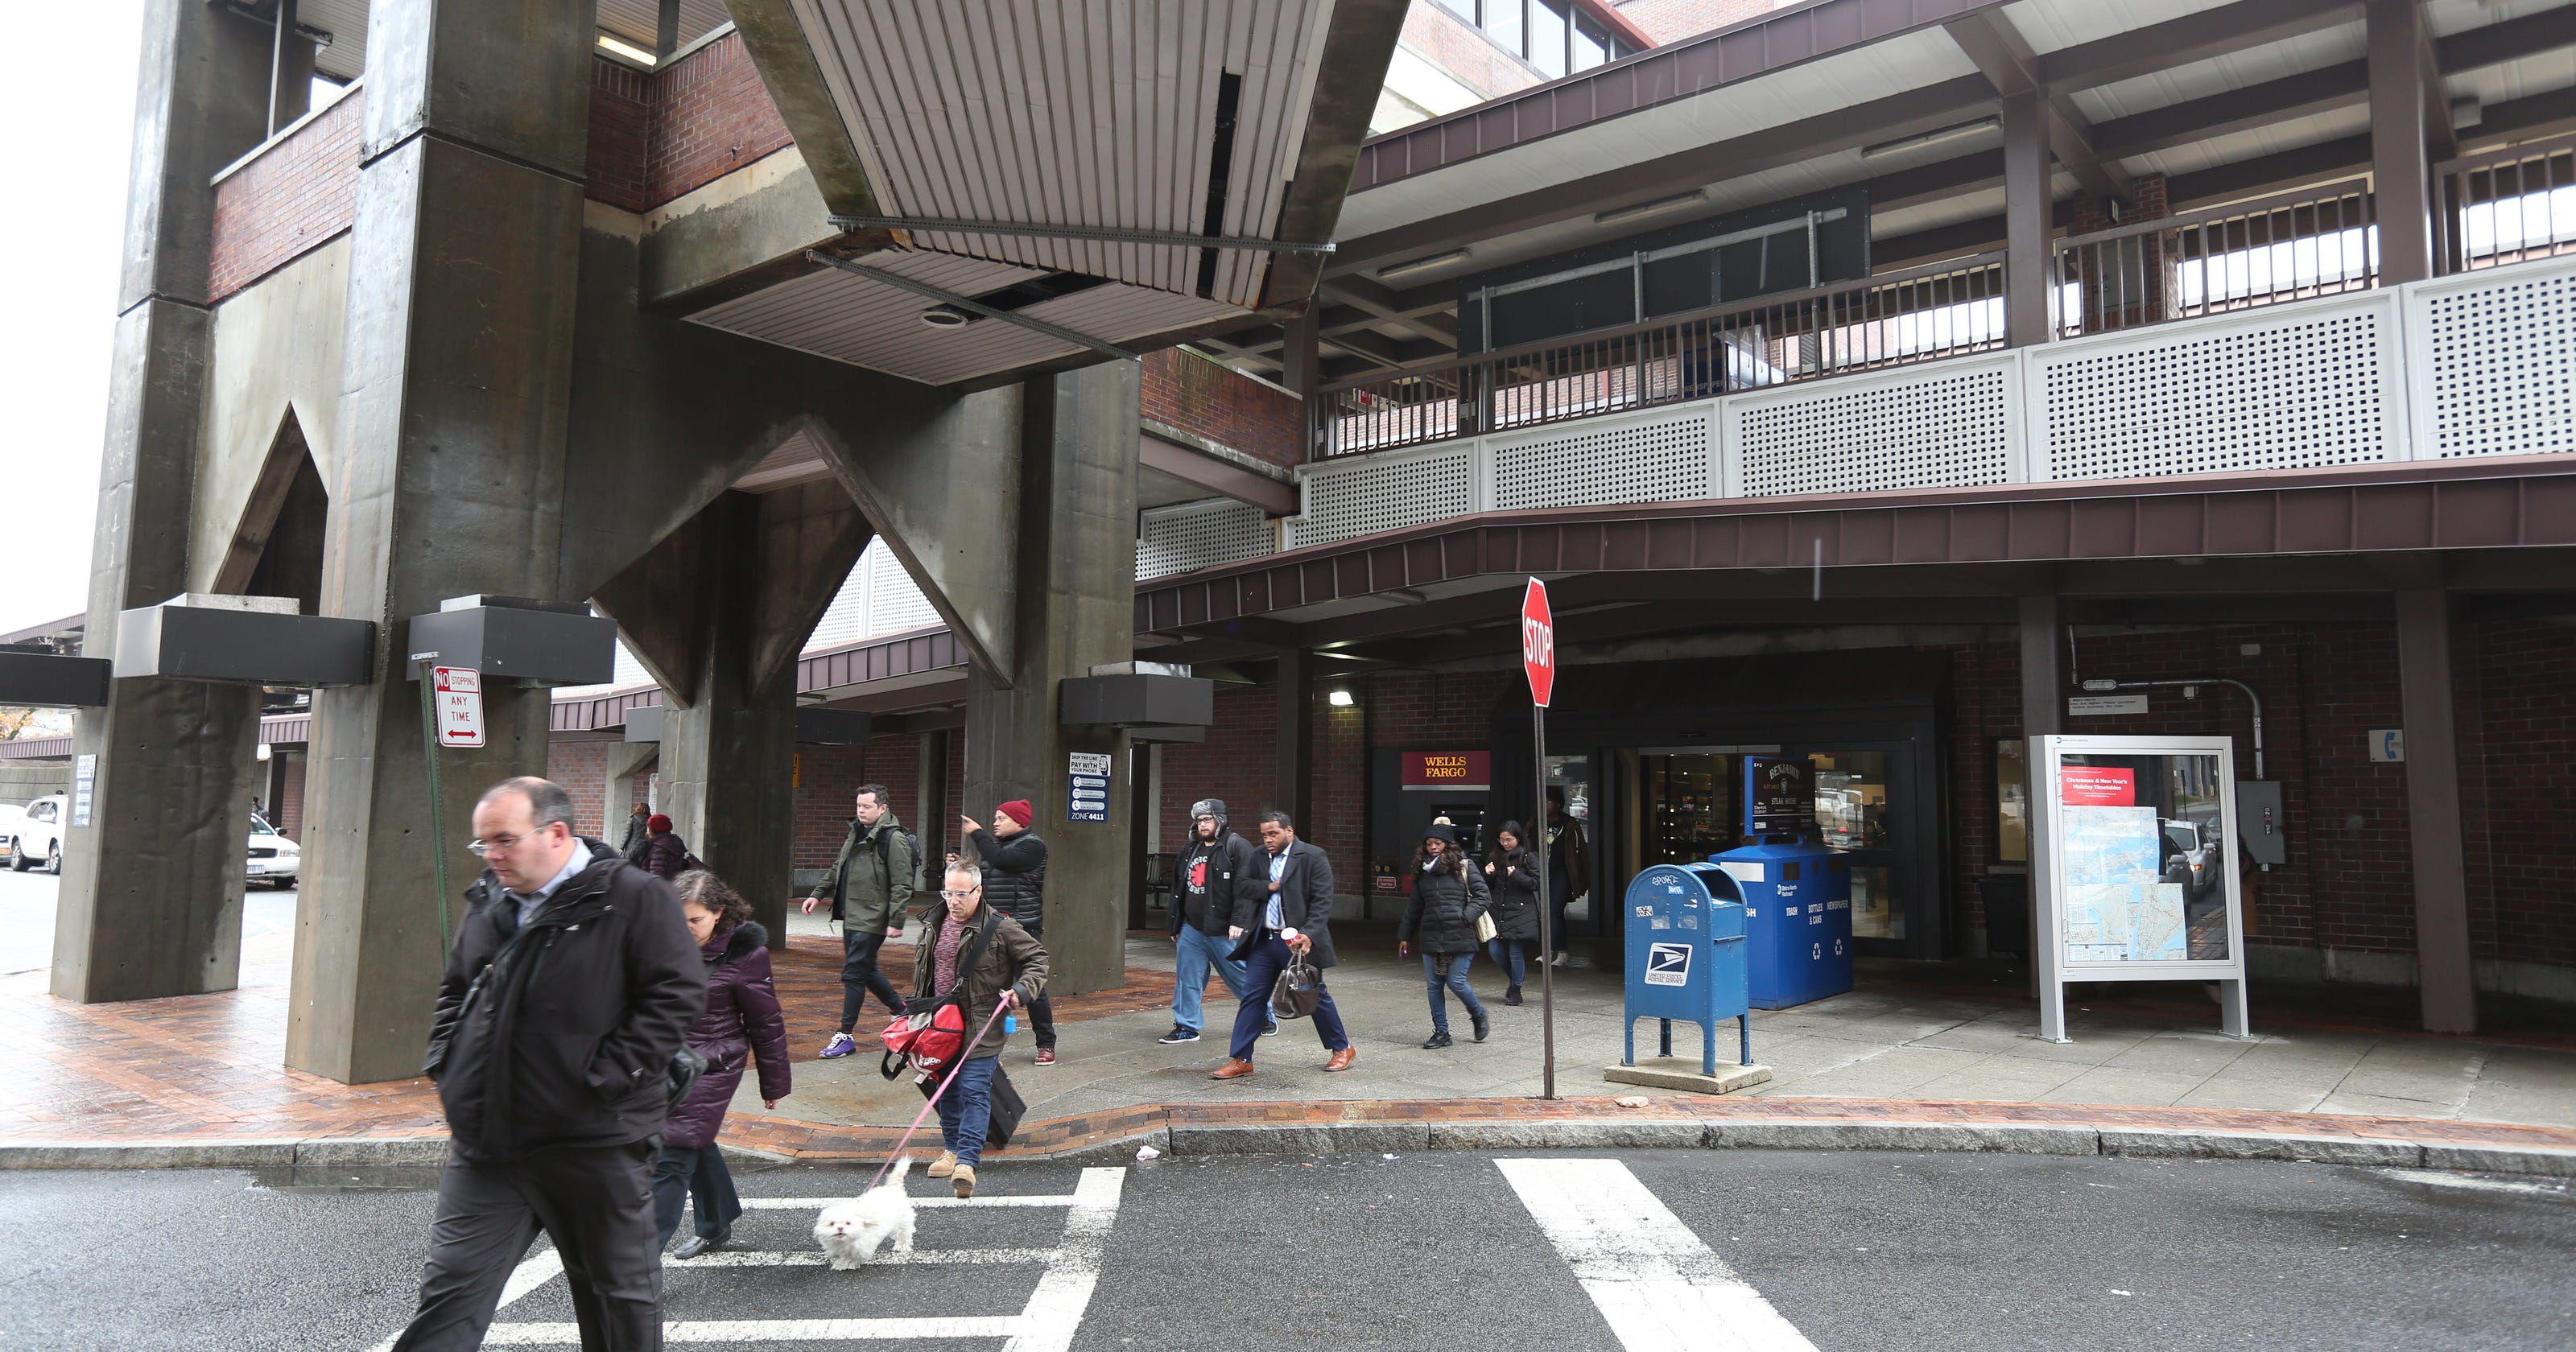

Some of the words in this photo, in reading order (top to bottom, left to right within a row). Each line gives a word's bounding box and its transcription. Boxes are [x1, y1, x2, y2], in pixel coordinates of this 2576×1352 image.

[1525, 616, 1551, 668] STOP
[436, 672, 449, 687] NO
[451, 676, 475, 686] STOPPING
[451, 696, 468, 706] ANY
[451, 711, 470, 721] TIME
[1424, 756, 1467, 766] WELLS
[1425, 768, 1467, 777] FARGO
[1769, 763, 1801, 780] BENJAMIN
[1071, 812, 1088, 820] ZONE
[1808, 903, 1823, 913] BOTTLES
[1827, 900, 1848, 910] NEWSPAPER
[1785, 907, 1798, 916] TRASH
[1813, 915, 1822, 925] CANS
